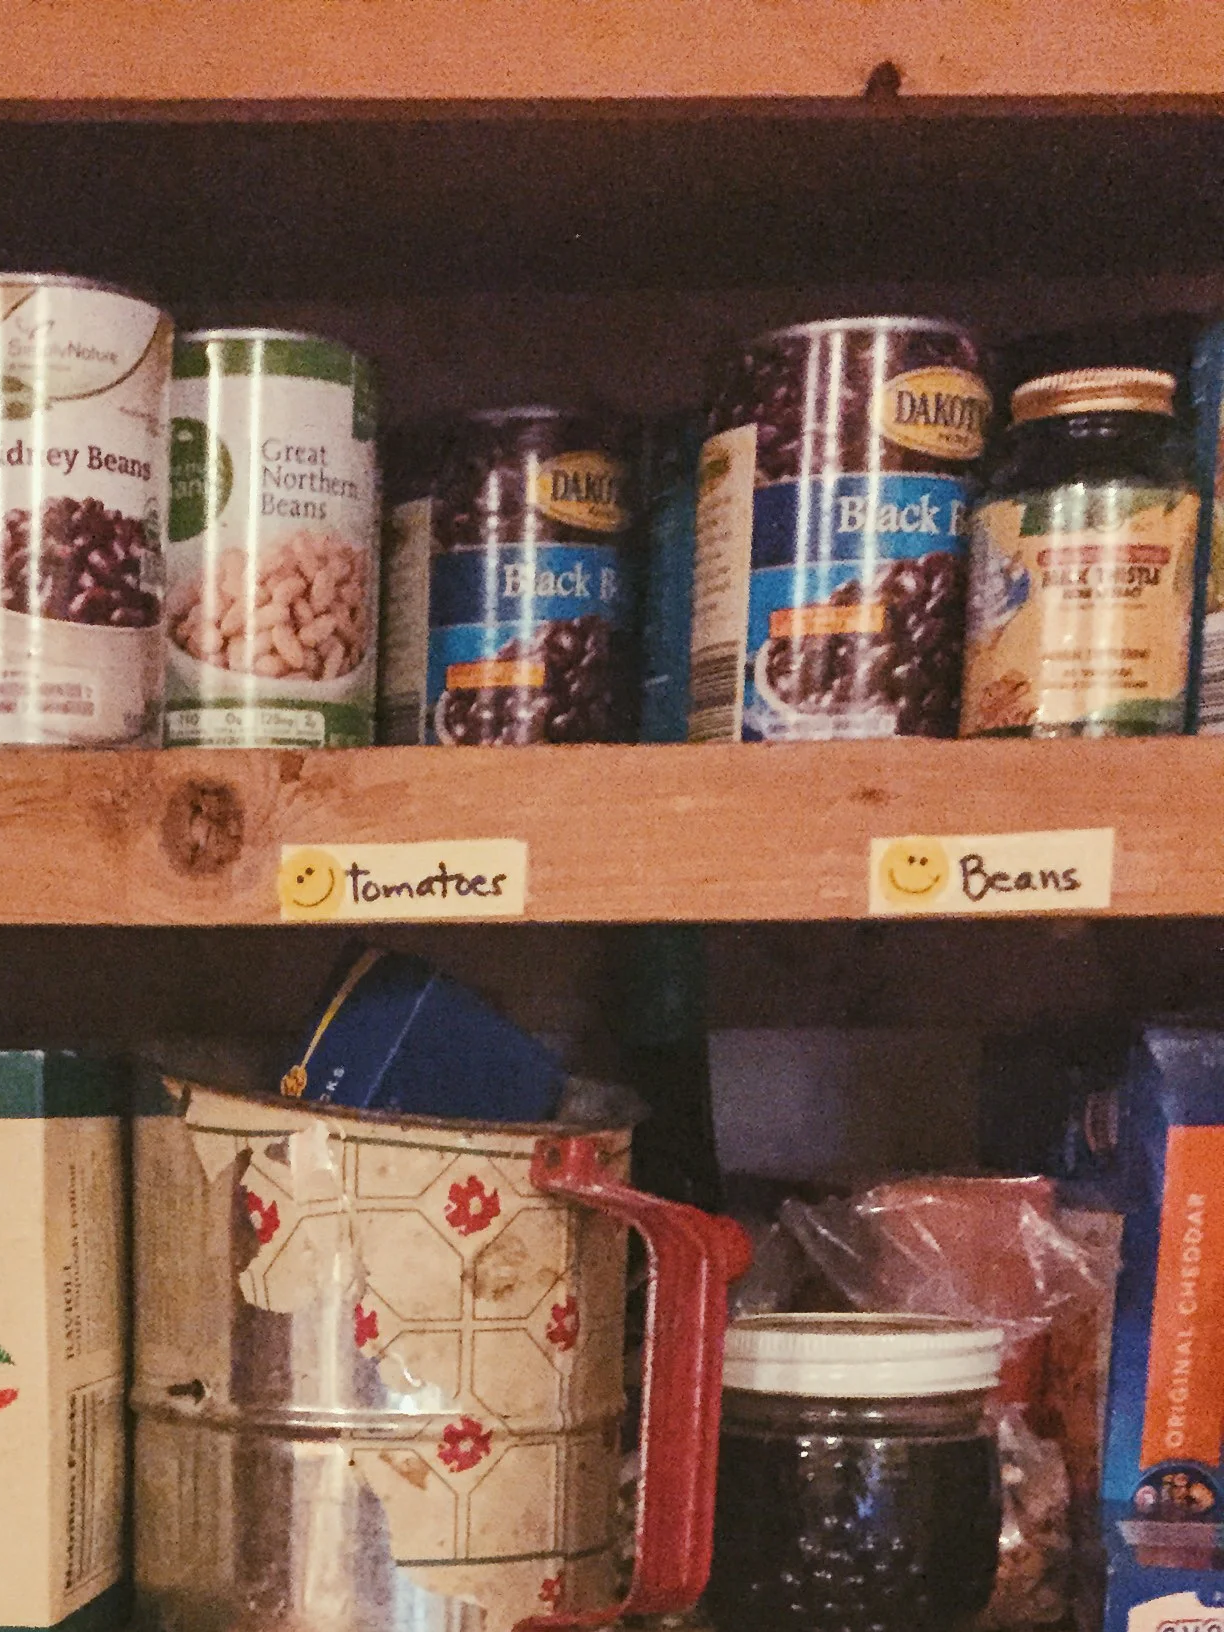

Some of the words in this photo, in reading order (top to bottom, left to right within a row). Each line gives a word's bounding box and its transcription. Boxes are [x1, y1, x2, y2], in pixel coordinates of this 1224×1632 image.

[87, 445, 152, 482] Beans
[261, 437, 328, 466] Great
[261, 491, 328, 521] Beans
[837, 493, 941, 536] Back
[502, 563, 592, 598] Back
[959, 852, 1082, 903] Beans
[1178, 1193, 1208, 1316] CHEDDAR
[1166, 1326, 1195, 1449] ORIGINAL
